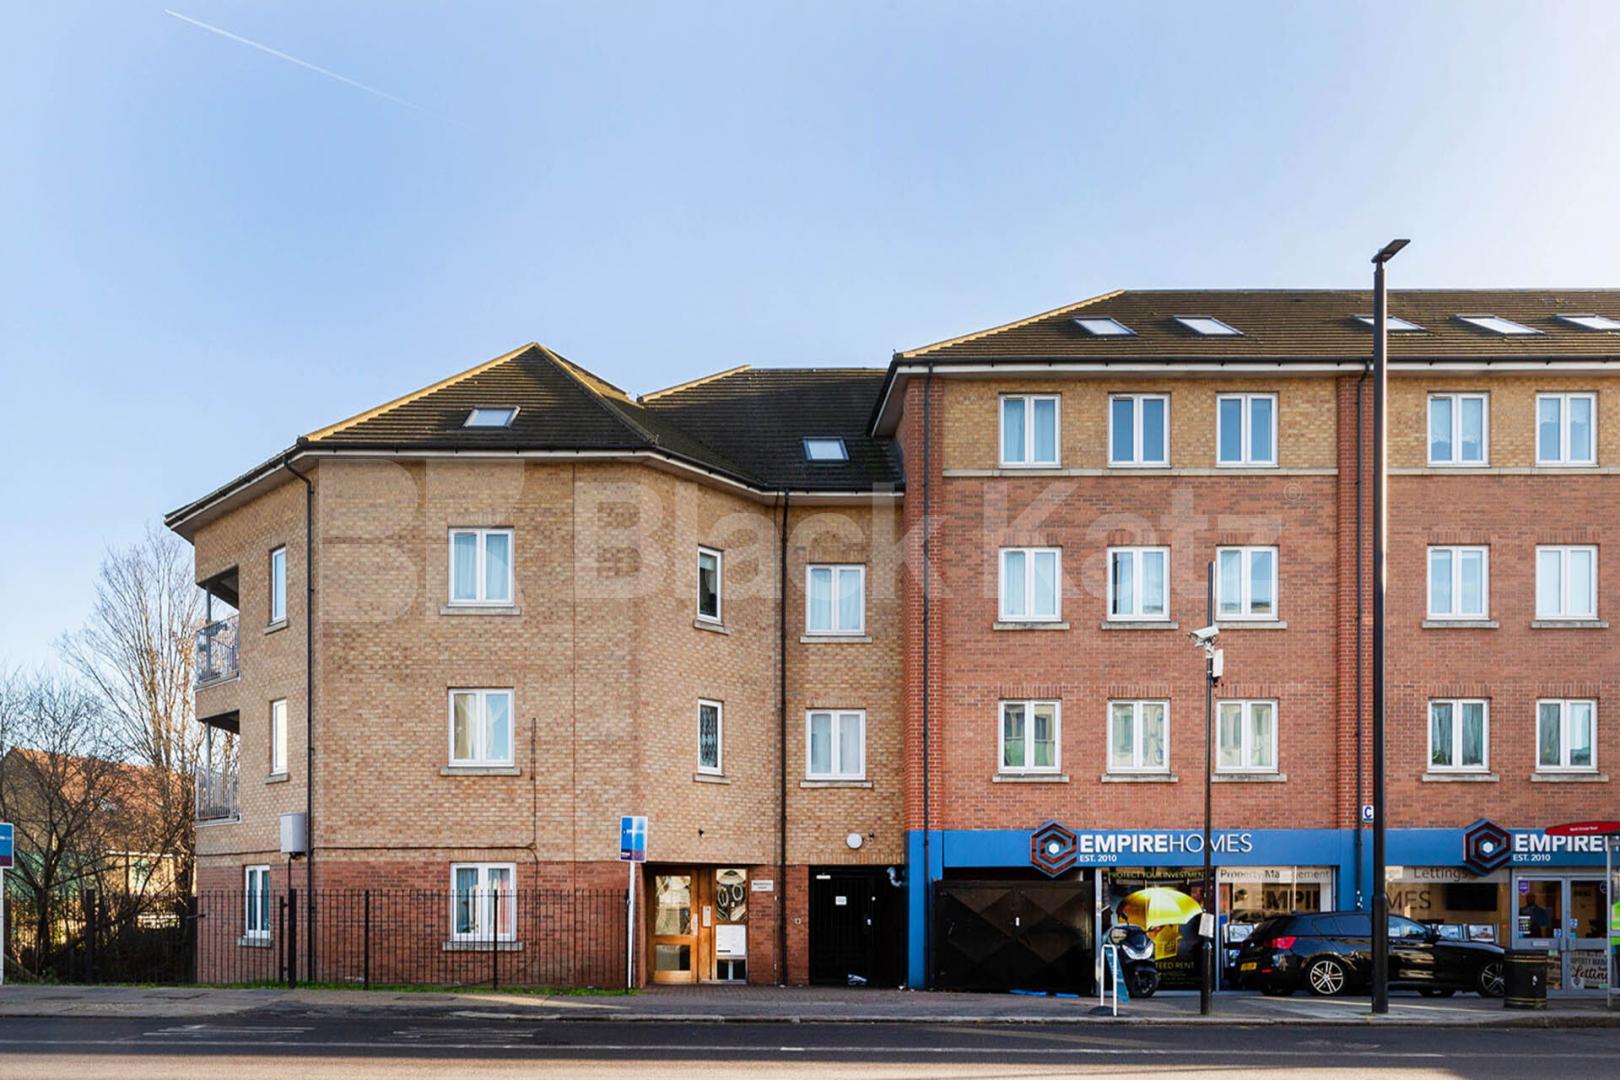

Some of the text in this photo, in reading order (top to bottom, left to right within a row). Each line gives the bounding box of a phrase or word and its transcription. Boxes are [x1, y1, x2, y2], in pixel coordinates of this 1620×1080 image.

[1364, 806, 1373, 818] C
[1080, 833, 1253, 854] EMPIREHOMES
[1079, 854, 1117, 863] EST. 2010
[1513, 853, 1551, 862] EST. 2010
[1386, 890, 1432, 910] MES
